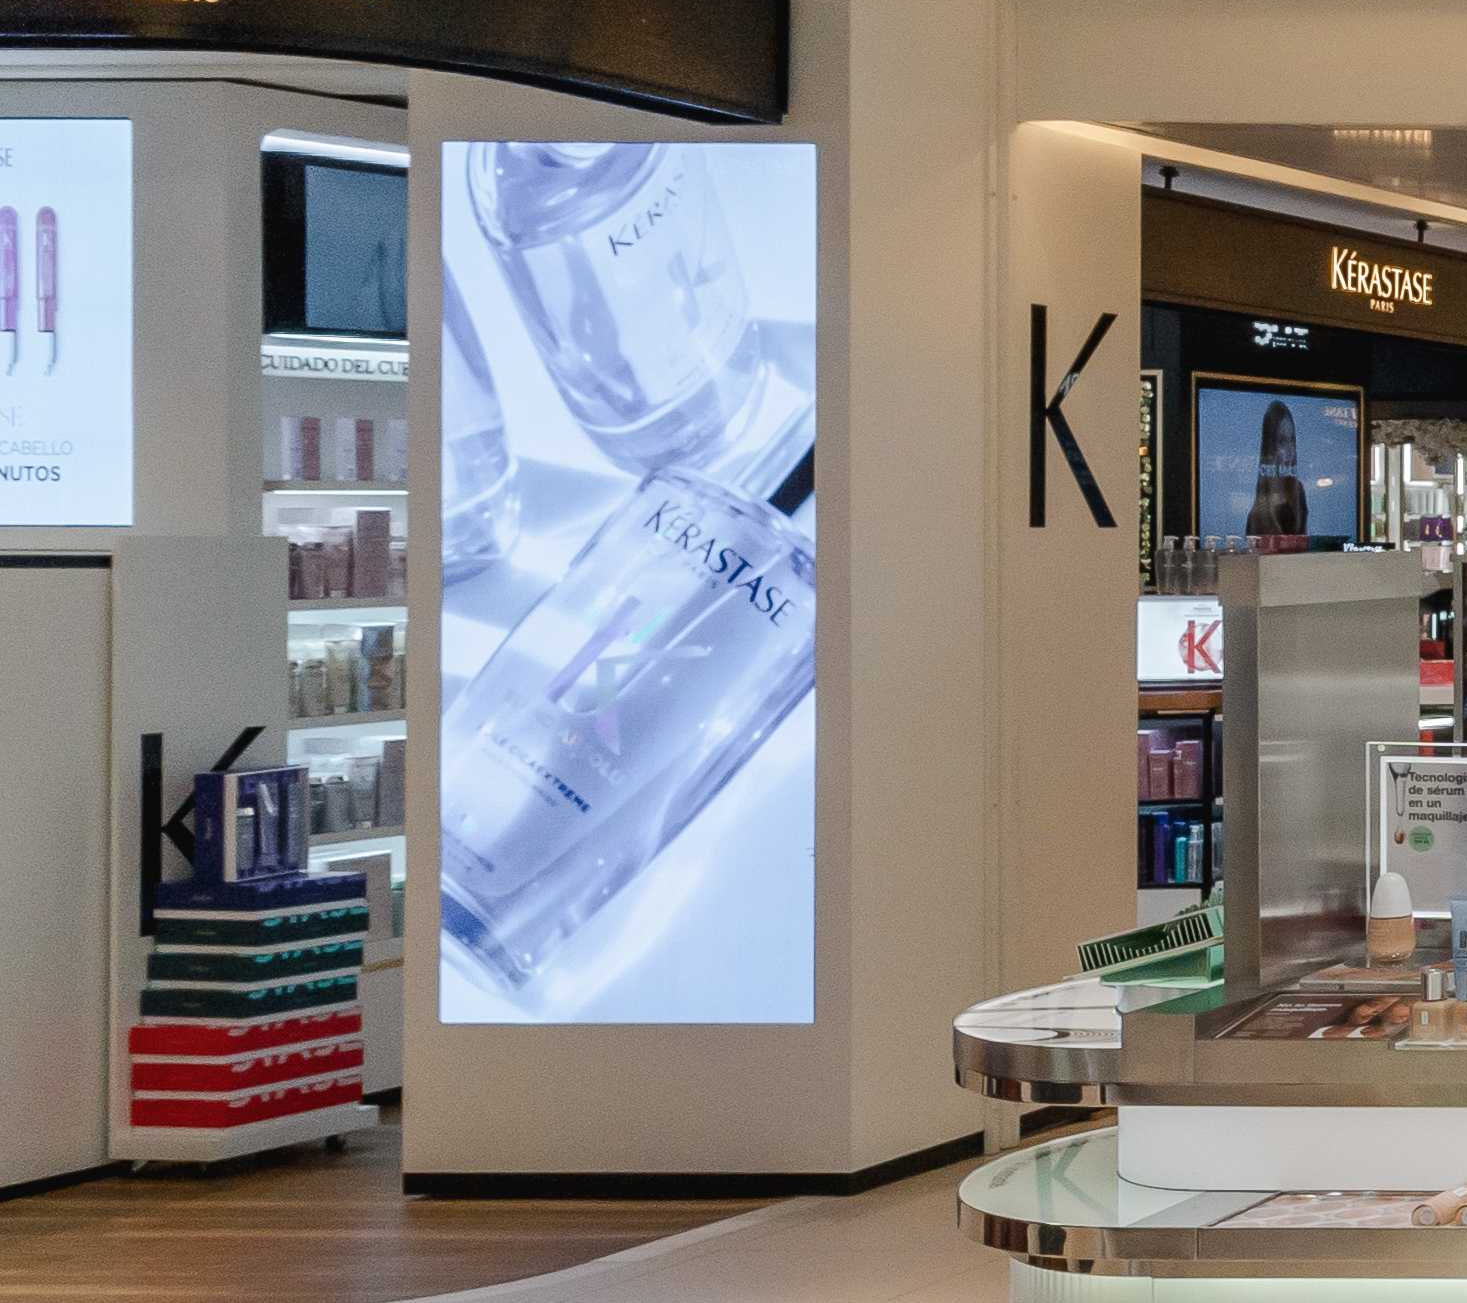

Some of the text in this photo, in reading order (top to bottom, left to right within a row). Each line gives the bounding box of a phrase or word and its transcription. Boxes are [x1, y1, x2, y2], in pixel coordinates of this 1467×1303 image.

[1330, 246, 1433, 305] KÉRASTASE
[1369, 299, 1395, 314] PARIS
[342, 359, 373, 374] DEL
[1029, 304, 1118, 528] K
[642, 499, 796, 628] KÉRASTASE
[1409, 786, 1464, 796] de sérum
[1409, 800, 1441, 808] en un
